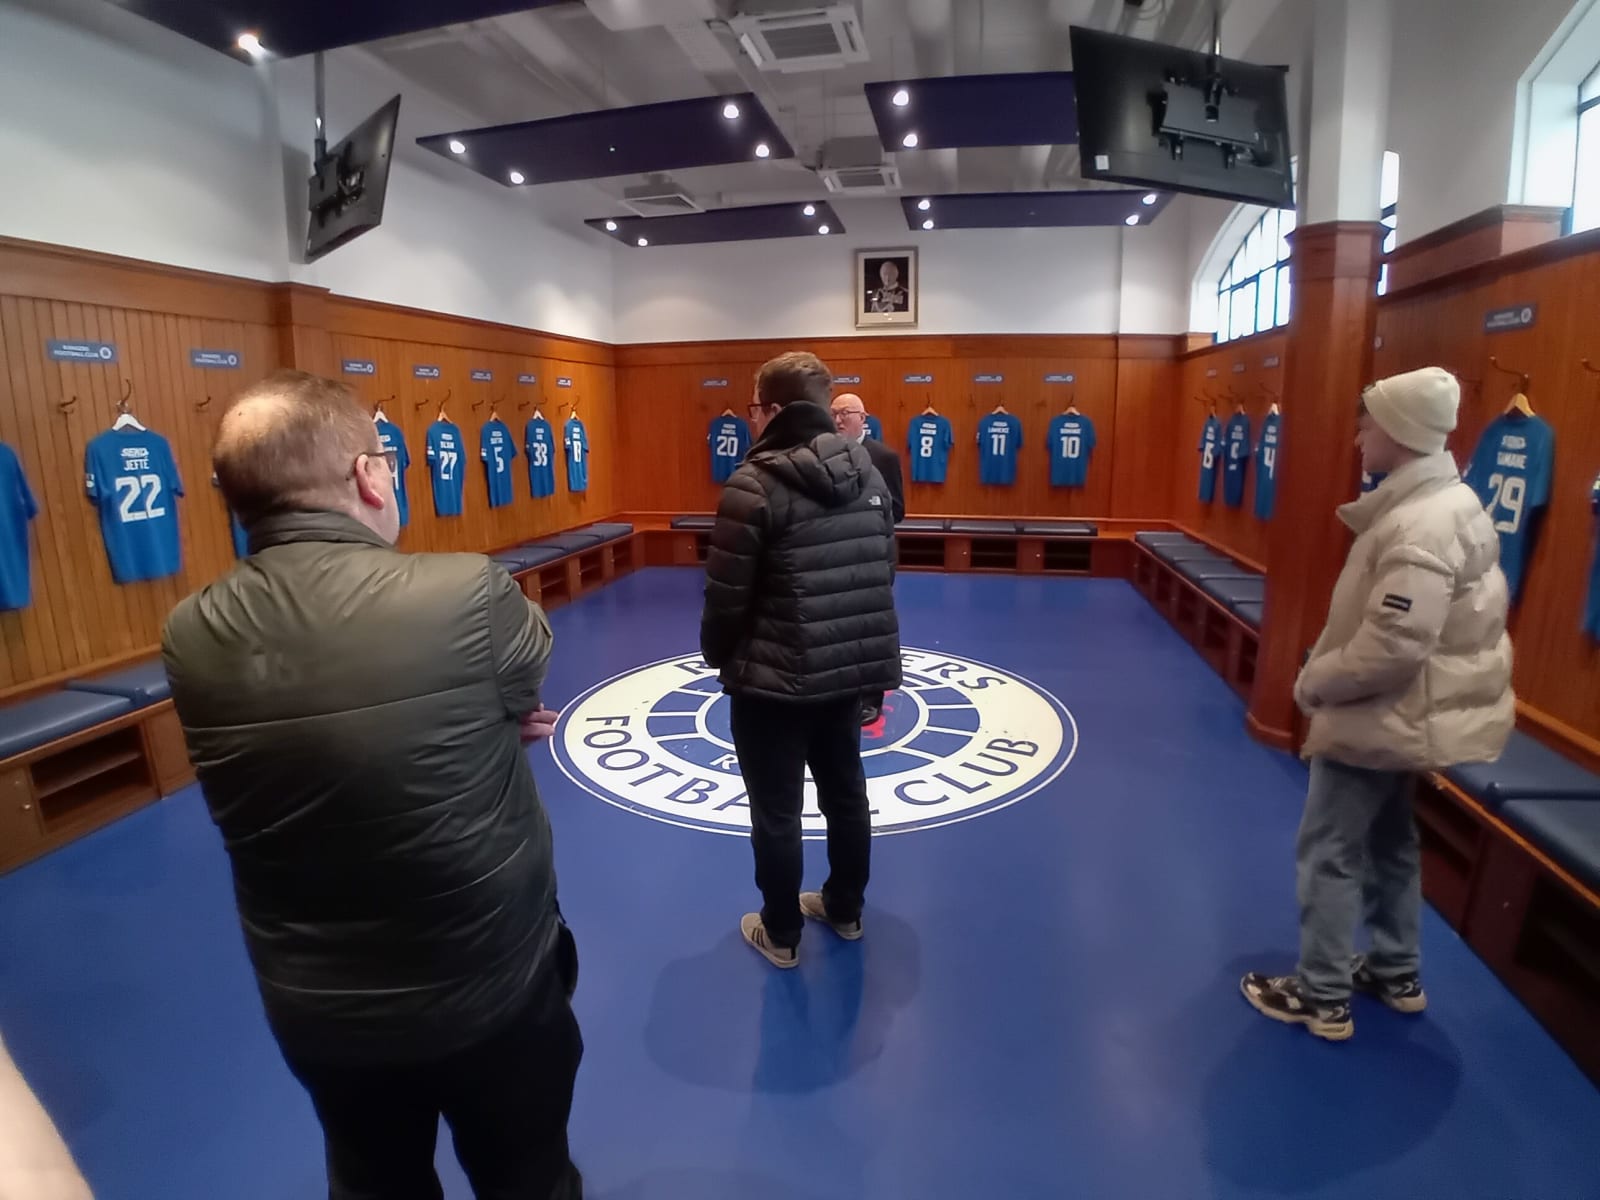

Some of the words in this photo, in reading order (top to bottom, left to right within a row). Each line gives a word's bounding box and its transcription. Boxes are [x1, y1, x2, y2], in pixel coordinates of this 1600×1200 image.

[716, 435, 739, 457] 20
[920, 436, 933, 458] 8
[991, 434, 1006, 456] 11
[1060, 436, 1081, 458] 10
[439, 450, 458, 480] 27
[493, 446, 504, 473] 5
[1264, 446, 1276, 480] 4
[115, 473, 166, 523] 22
[1487, 473, 1527, 534] 29
[893, 738, 1039, 806] CLUB
